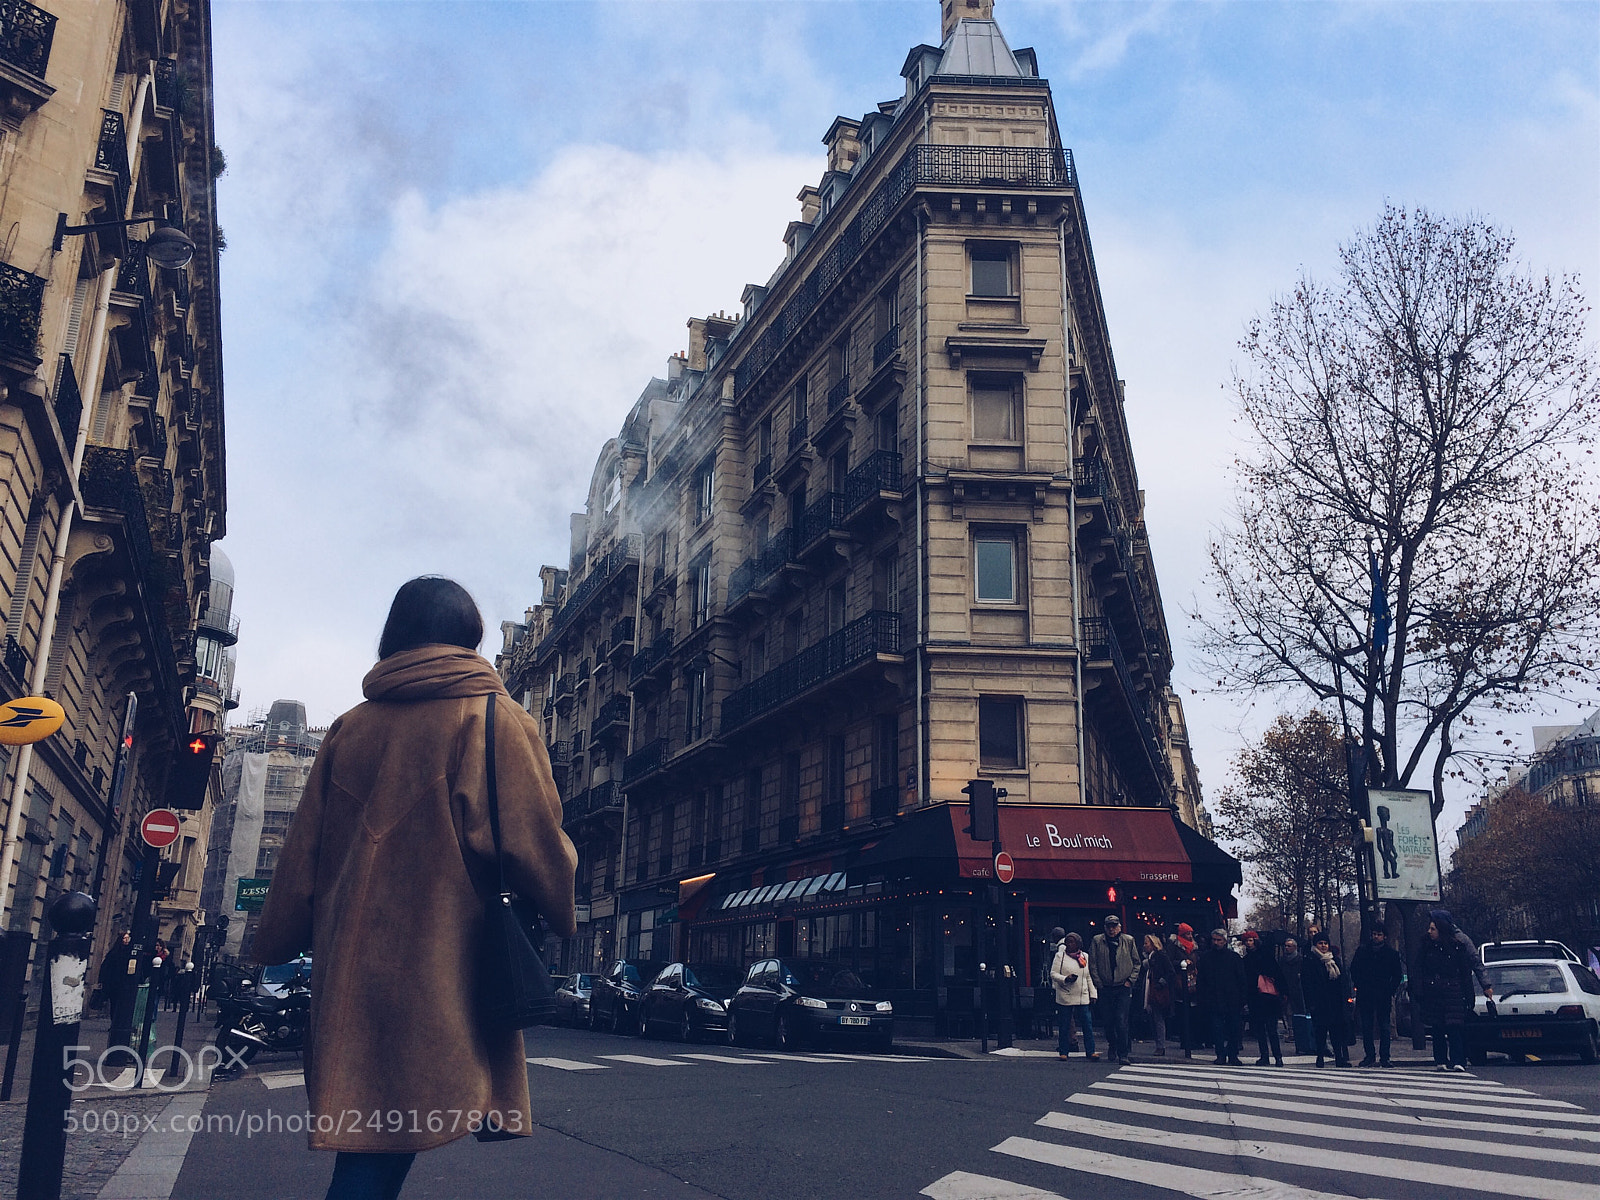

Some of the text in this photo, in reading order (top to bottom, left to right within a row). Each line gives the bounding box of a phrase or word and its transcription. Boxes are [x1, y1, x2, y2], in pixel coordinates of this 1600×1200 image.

[1396, 822, 1410, 835] LES
[1025, 823, 1113, 849] Le Boul'mich
[1398, 844, 1432, 856] NATALES
[1140, 871, 1179, 881] brasserie
